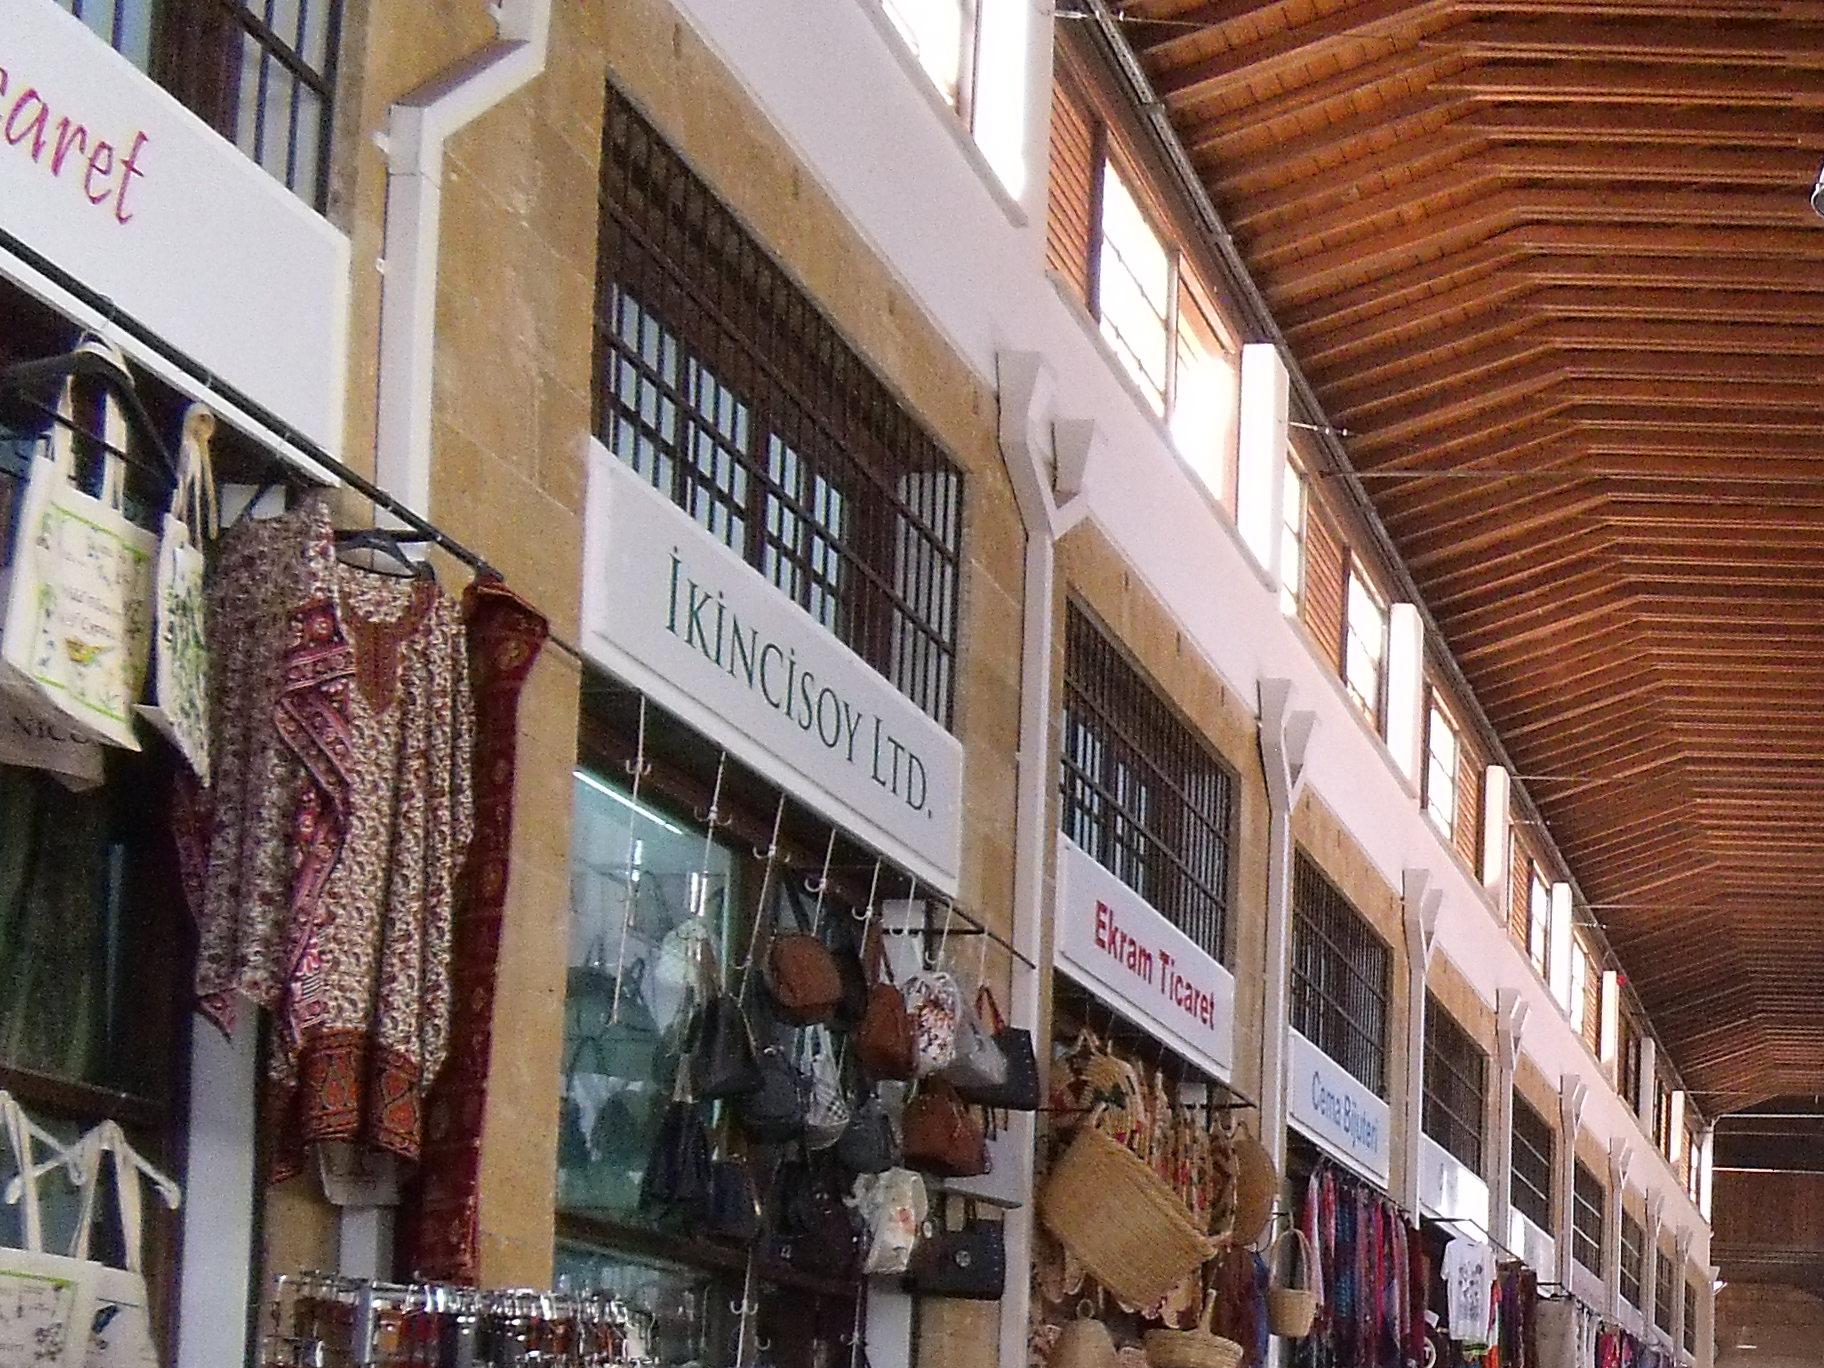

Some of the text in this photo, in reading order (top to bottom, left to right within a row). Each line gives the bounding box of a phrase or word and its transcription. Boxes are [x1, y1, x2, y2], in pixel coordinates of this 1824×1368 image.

[665, 545, 934, 820] İKİNCİSOY LTD.
[1093, 899, 1216, 1032] Ekram Ticaret
